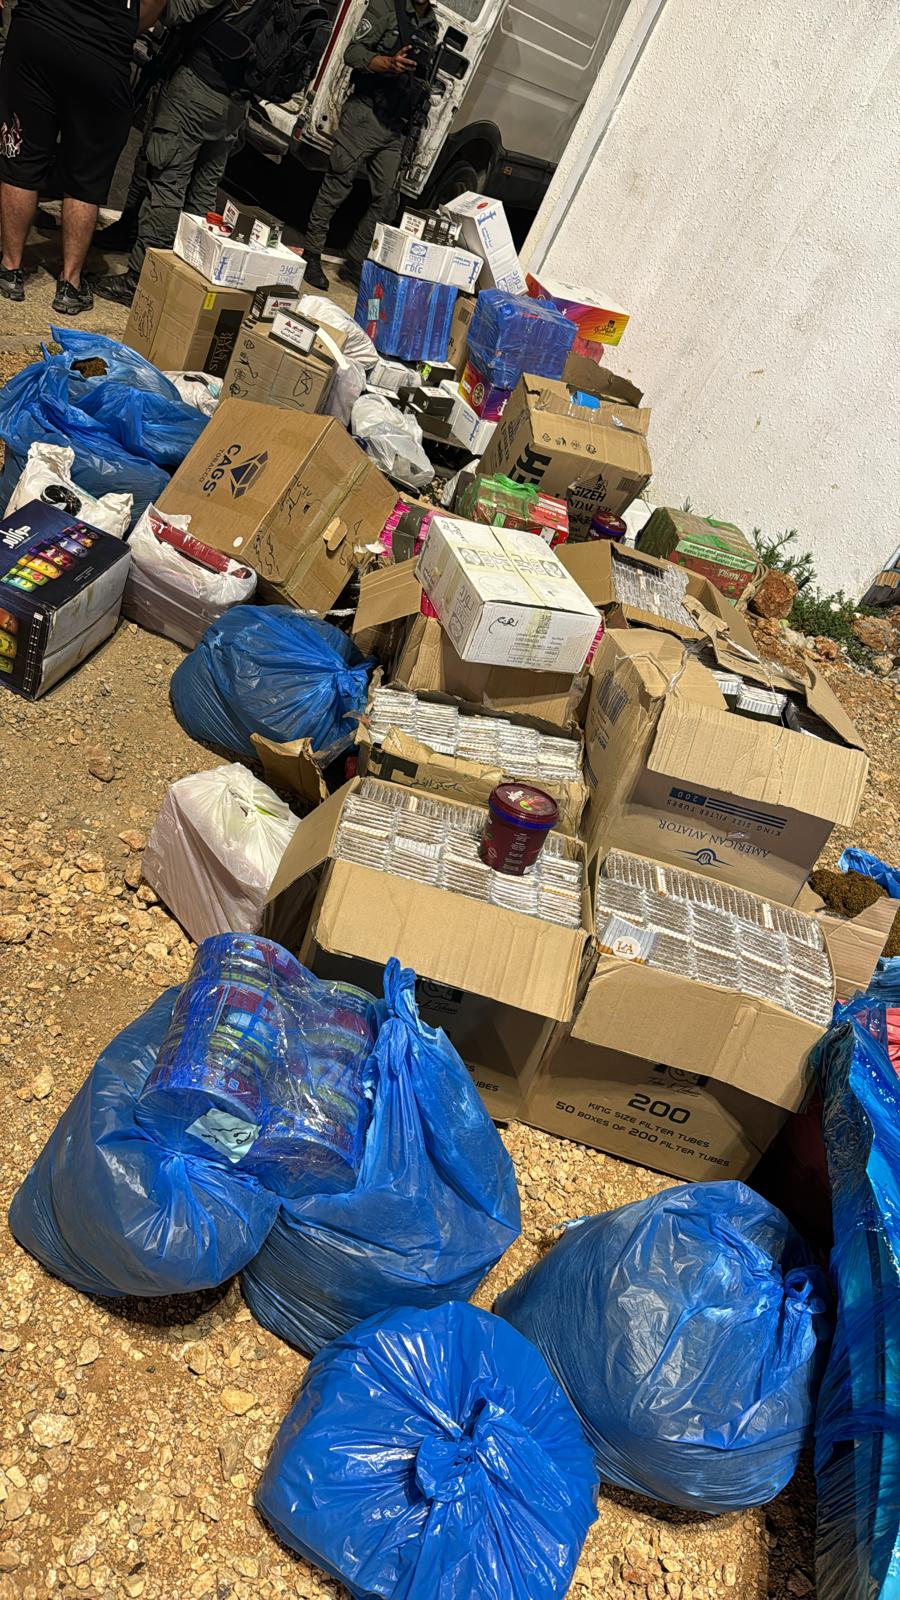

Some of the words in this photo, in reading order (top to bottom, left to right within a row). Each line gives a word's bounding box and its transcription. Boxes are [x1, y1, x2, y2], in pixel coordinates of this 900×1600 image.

[198, 447, 227, 484] TOBACCO
[202, 443, 242, 493] CAGS
[572, 485, 608, 503] GIZEH
[666, 798, 697, 813] TUBES
[677, 791, 698, 803] 200
[699, 808, 727, 823] FILTER
[730, 817, 753, 829] SIZE
[658, 818, 707, 840] AVIATOR
[756, 825, 782, 837] KING
[708, 832, 771, 858] AMERICAN
[474, 1079, 500, 1092] UBES
[626, 1092, 691, 1125] 200
[554, 1100, 576, 1115] 50
[576, 1110, 610, 1127] BOXES
[612, 1122, 627, 1132] OF
[627, 1127, 659, 1144] 200
[659, 1139, 696, 1157] FILTER
[698, 1152, 731, 1168] TUBES
[587, 1101, 611, 1115] KING
[614, 1109, 637, 1124] SIZE
[638, 1119, 675, 1138] FILTER
[678, 1132, 711, 1149] TUBES
